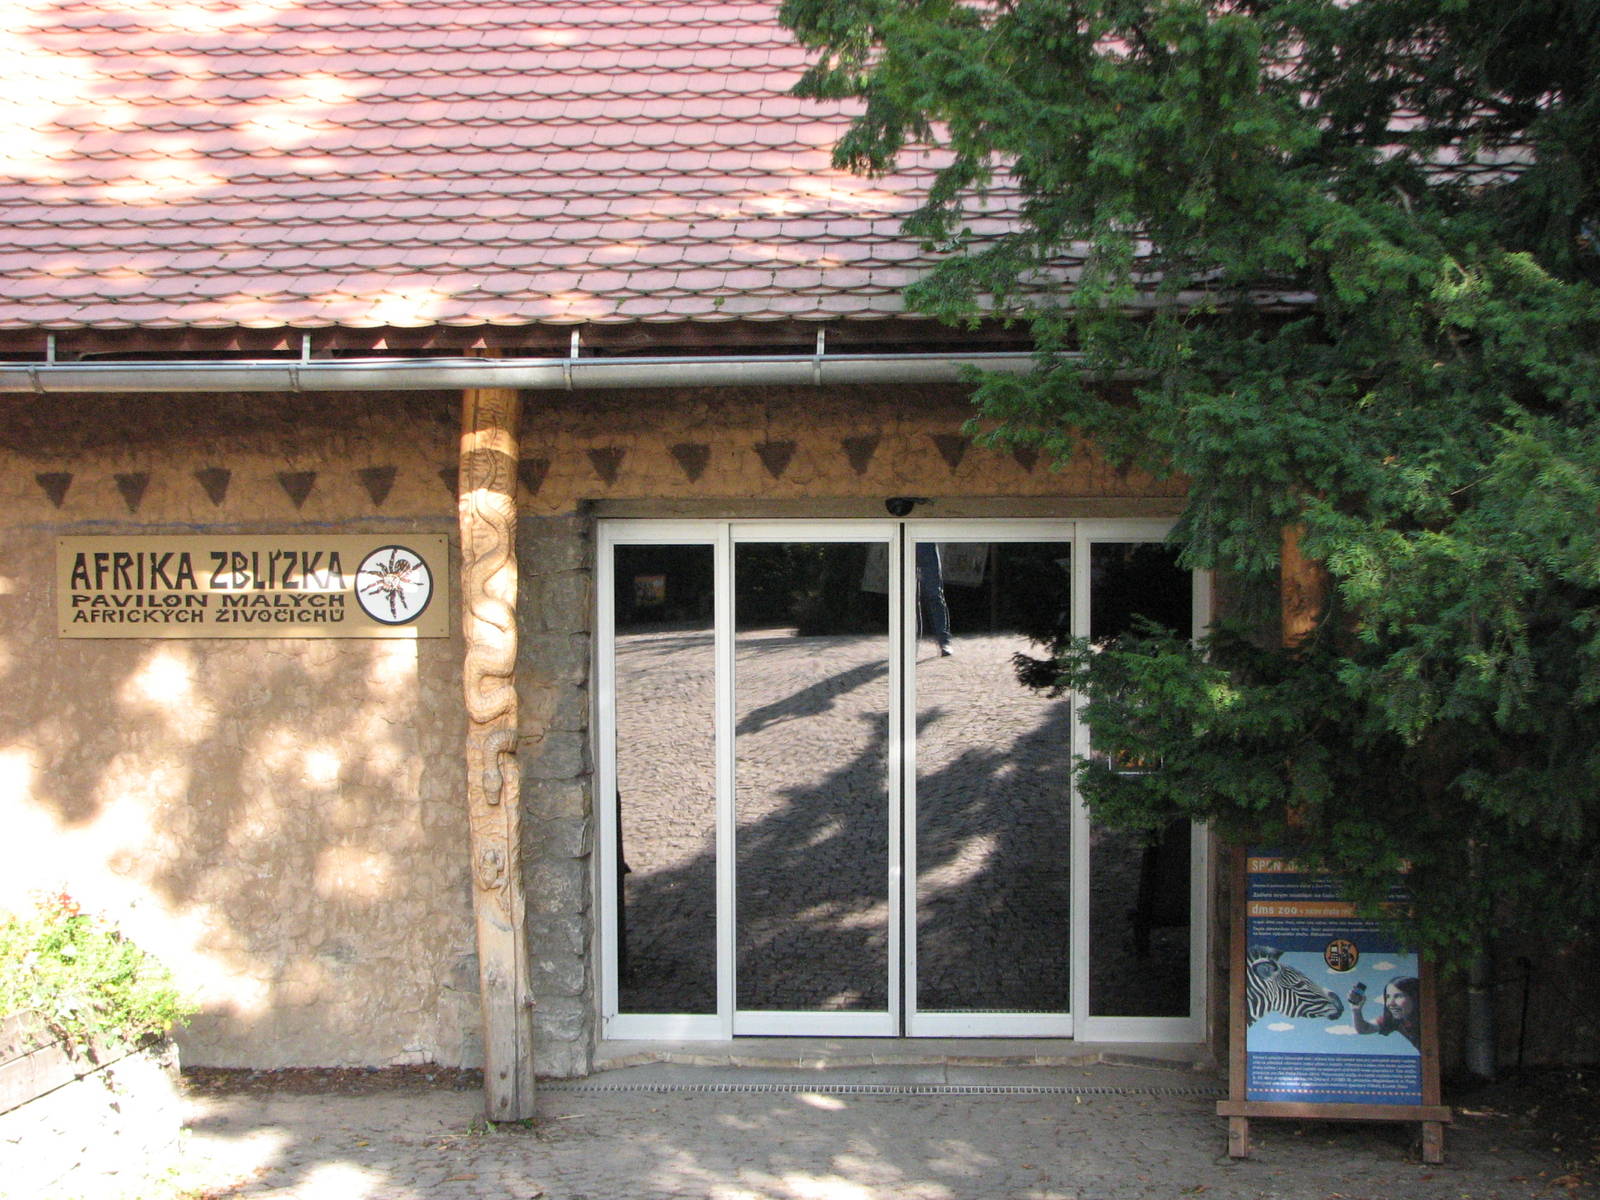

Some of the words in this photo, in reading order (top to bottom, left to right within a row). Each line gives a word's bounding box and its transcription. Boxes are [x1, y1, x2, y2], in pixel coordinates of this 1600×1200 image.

[71, 552, 198, 590] AFRIKA
[209, 549, 347, 590] ZBLÍZKA
[72, 595, 208, 607] PAVILON
[223, 593, 345, 607] MALÝCH
[73, 610, 203, 624] AFRICKÝCH
[1252, 903, 1274, 915] dms
[1278, 906, 1297, 915] zoo
